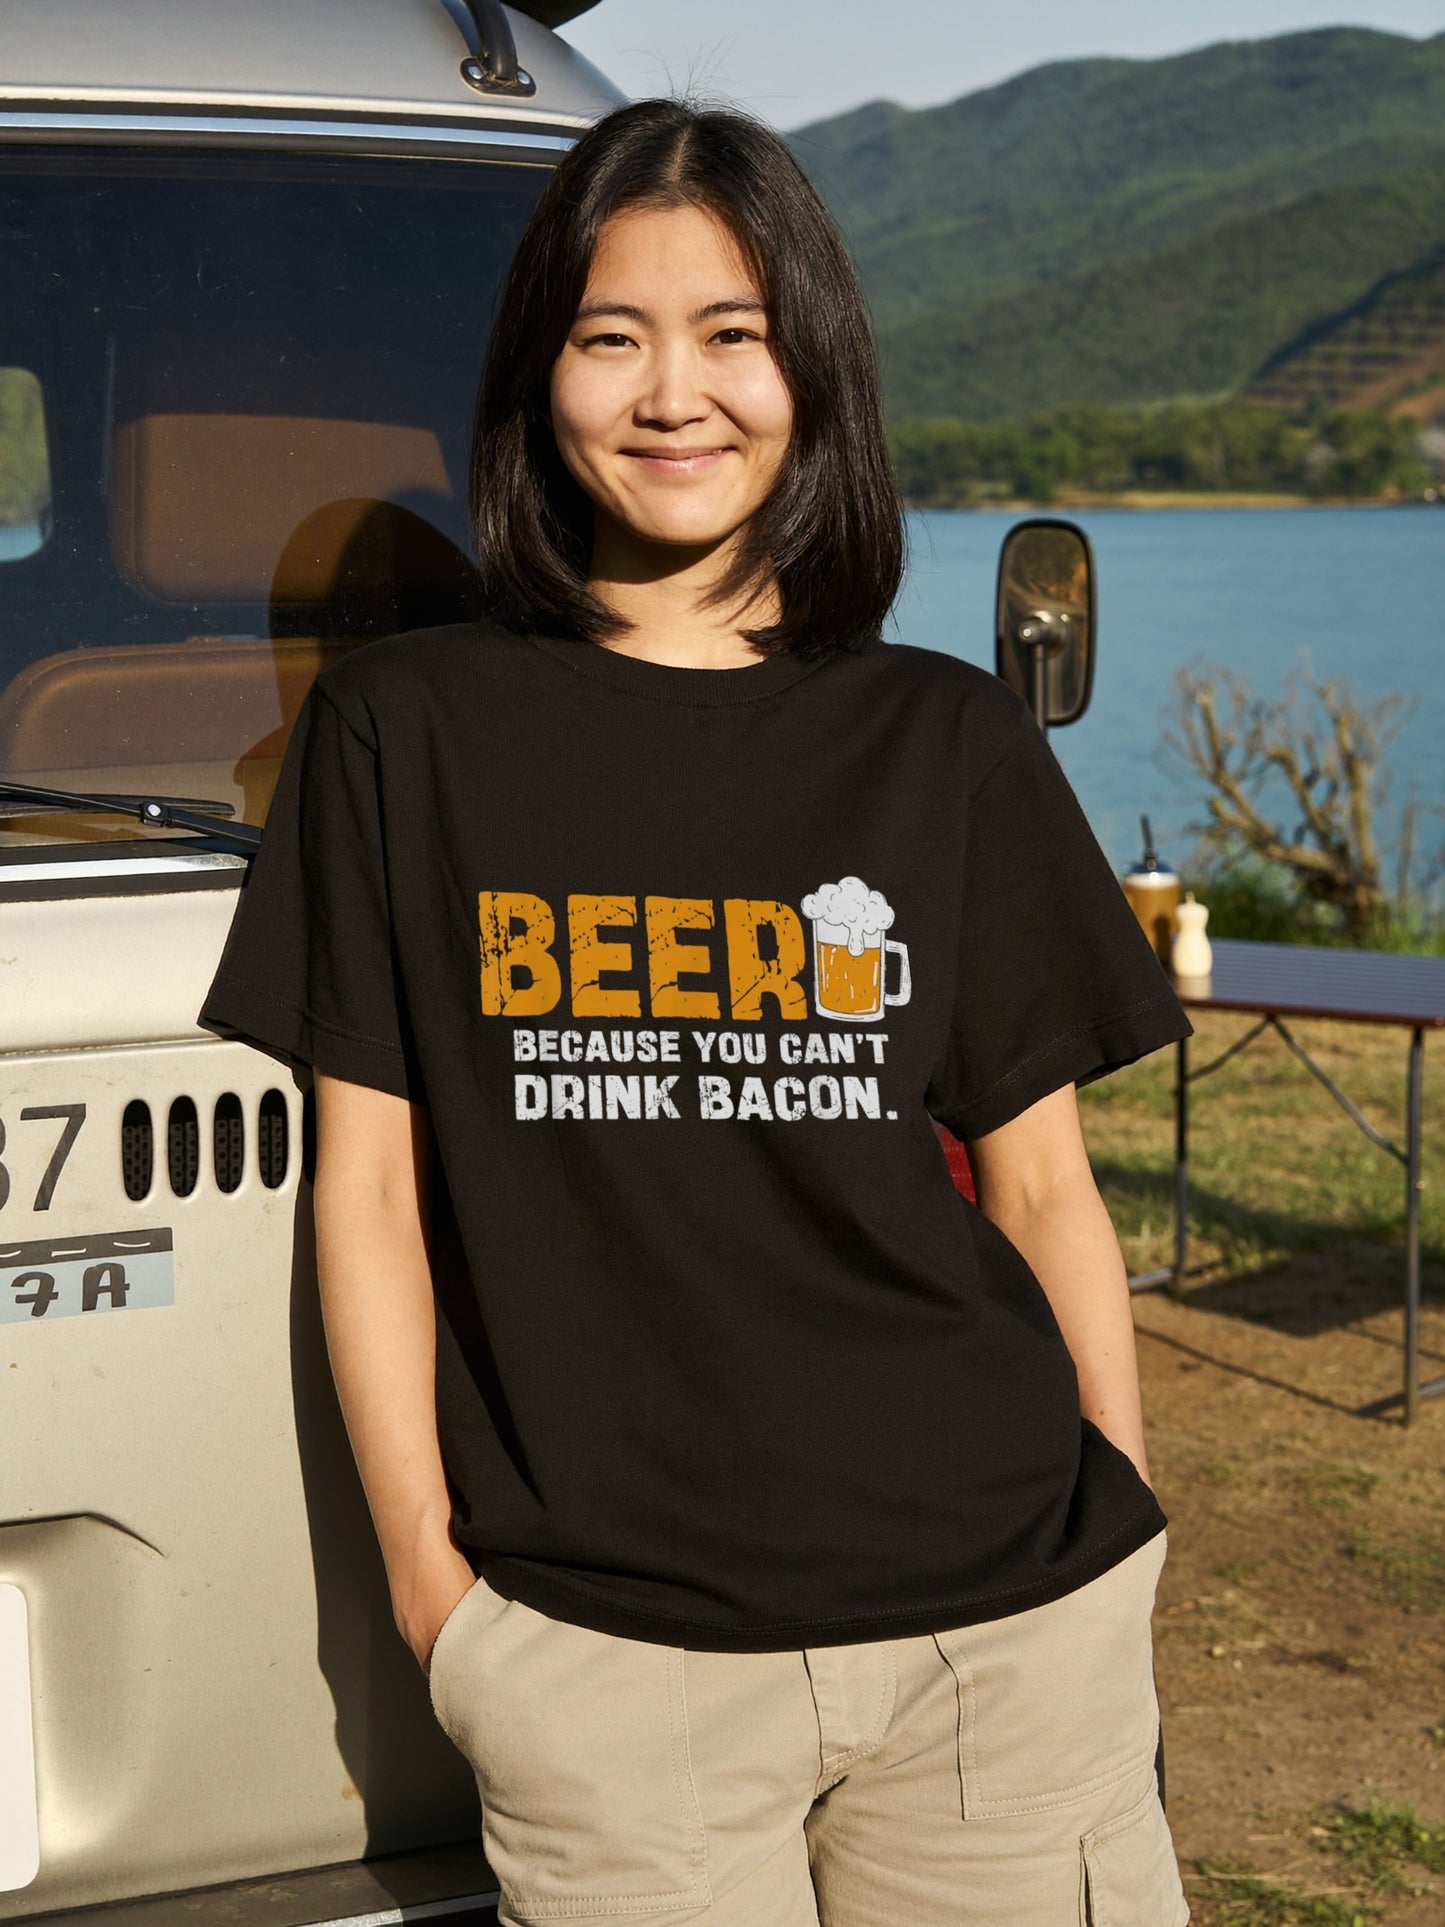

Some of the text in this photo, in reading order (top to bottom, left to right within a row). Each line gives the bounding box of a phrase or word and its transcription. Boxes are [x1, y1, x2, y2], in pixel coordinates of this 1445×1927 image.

[479, 891, 808, 1020] BEER
[513, 1029, 889, 1065] BECAUSE YOU CAN'T
[514, 1074, 898, 1121] DRINK BACON.
[0, 1103, 86, 1212] 7
